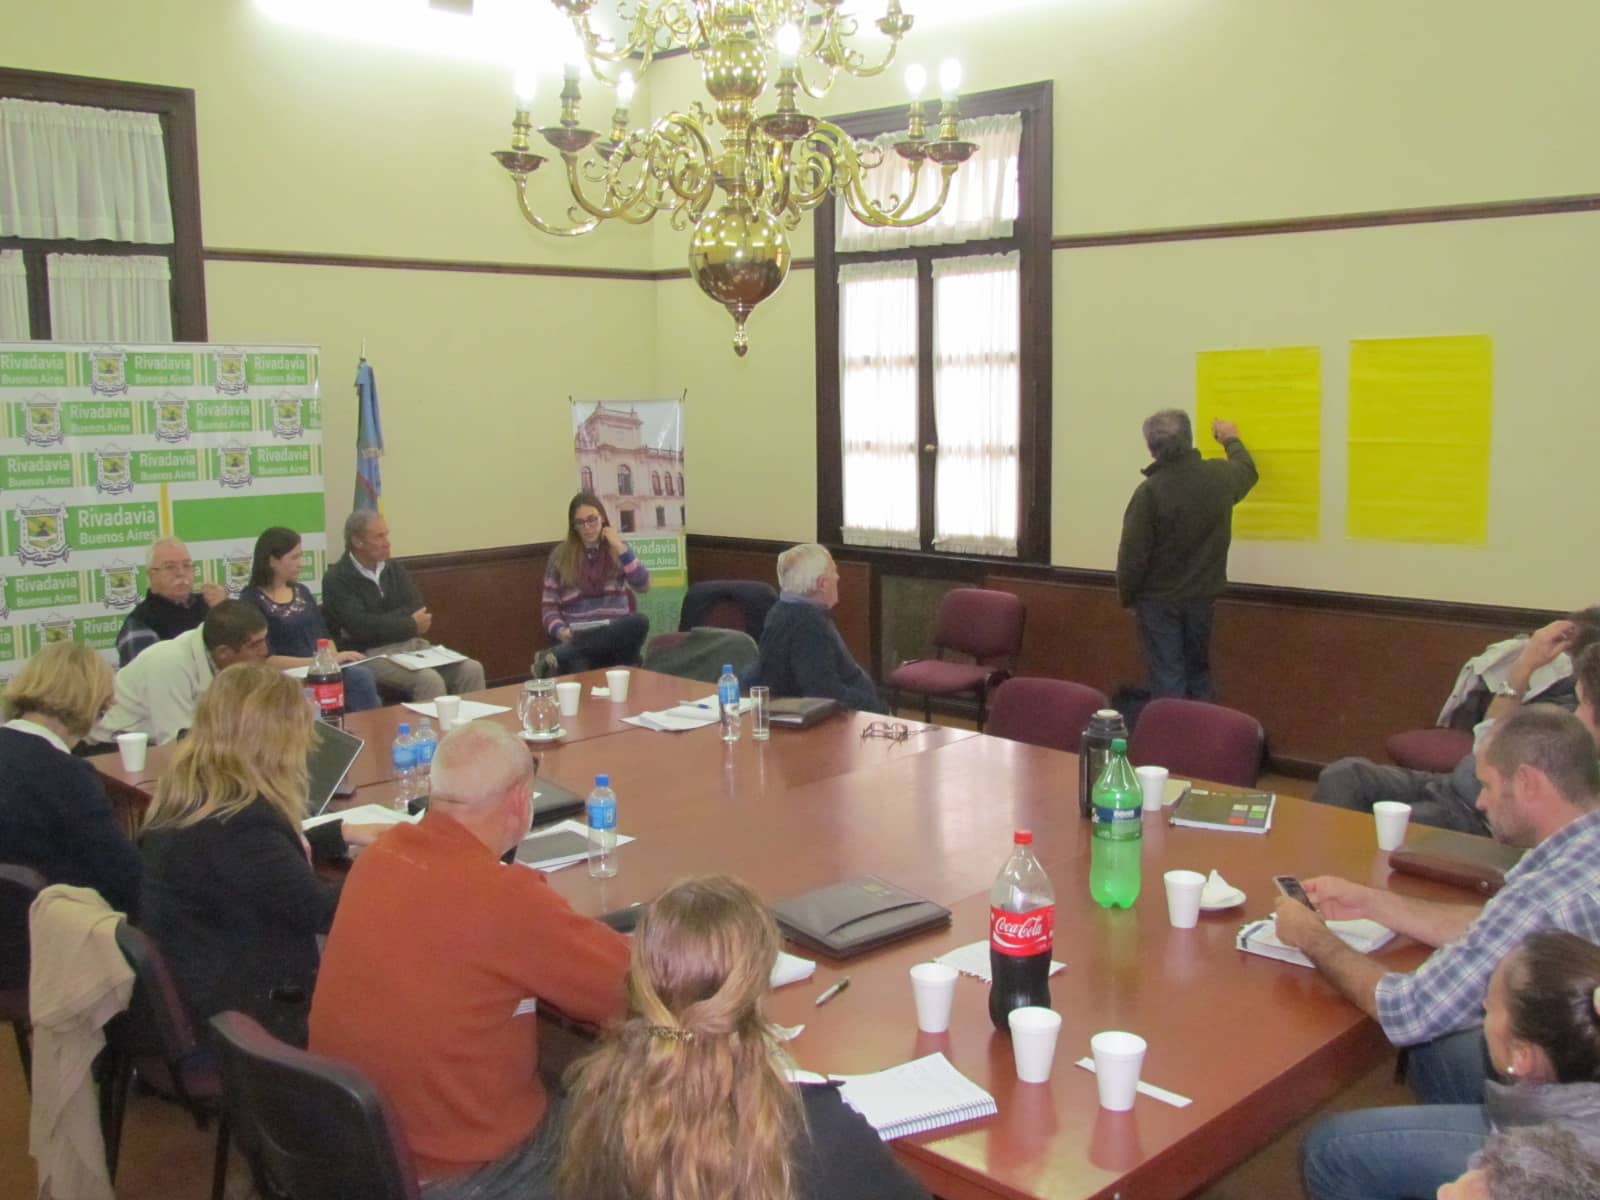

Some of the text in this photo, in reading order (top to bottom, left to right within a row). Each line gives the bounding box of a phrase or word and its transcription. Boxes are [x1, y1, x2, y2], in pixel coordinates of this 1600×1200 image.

[1, 353, 64, 370] Rivadavia
[134, 354, 192, 370] Rivadavia
[254, 355, 305, 370] Rivadavia
[70, 403, 130, 419] Rivadavia
[196, 402, 249, 416] Rivadavia
[139, 451, 195, 467] Rivadavia
[258, 447, 308, 462] Rivadavia
[7, 456, 70, 473] Rivadavia
[78, 505, 156, 528] Rivadavia
[80, 529, 156, 545] Buenos Aires
[15, 573, 78, 593] Rivadavia
